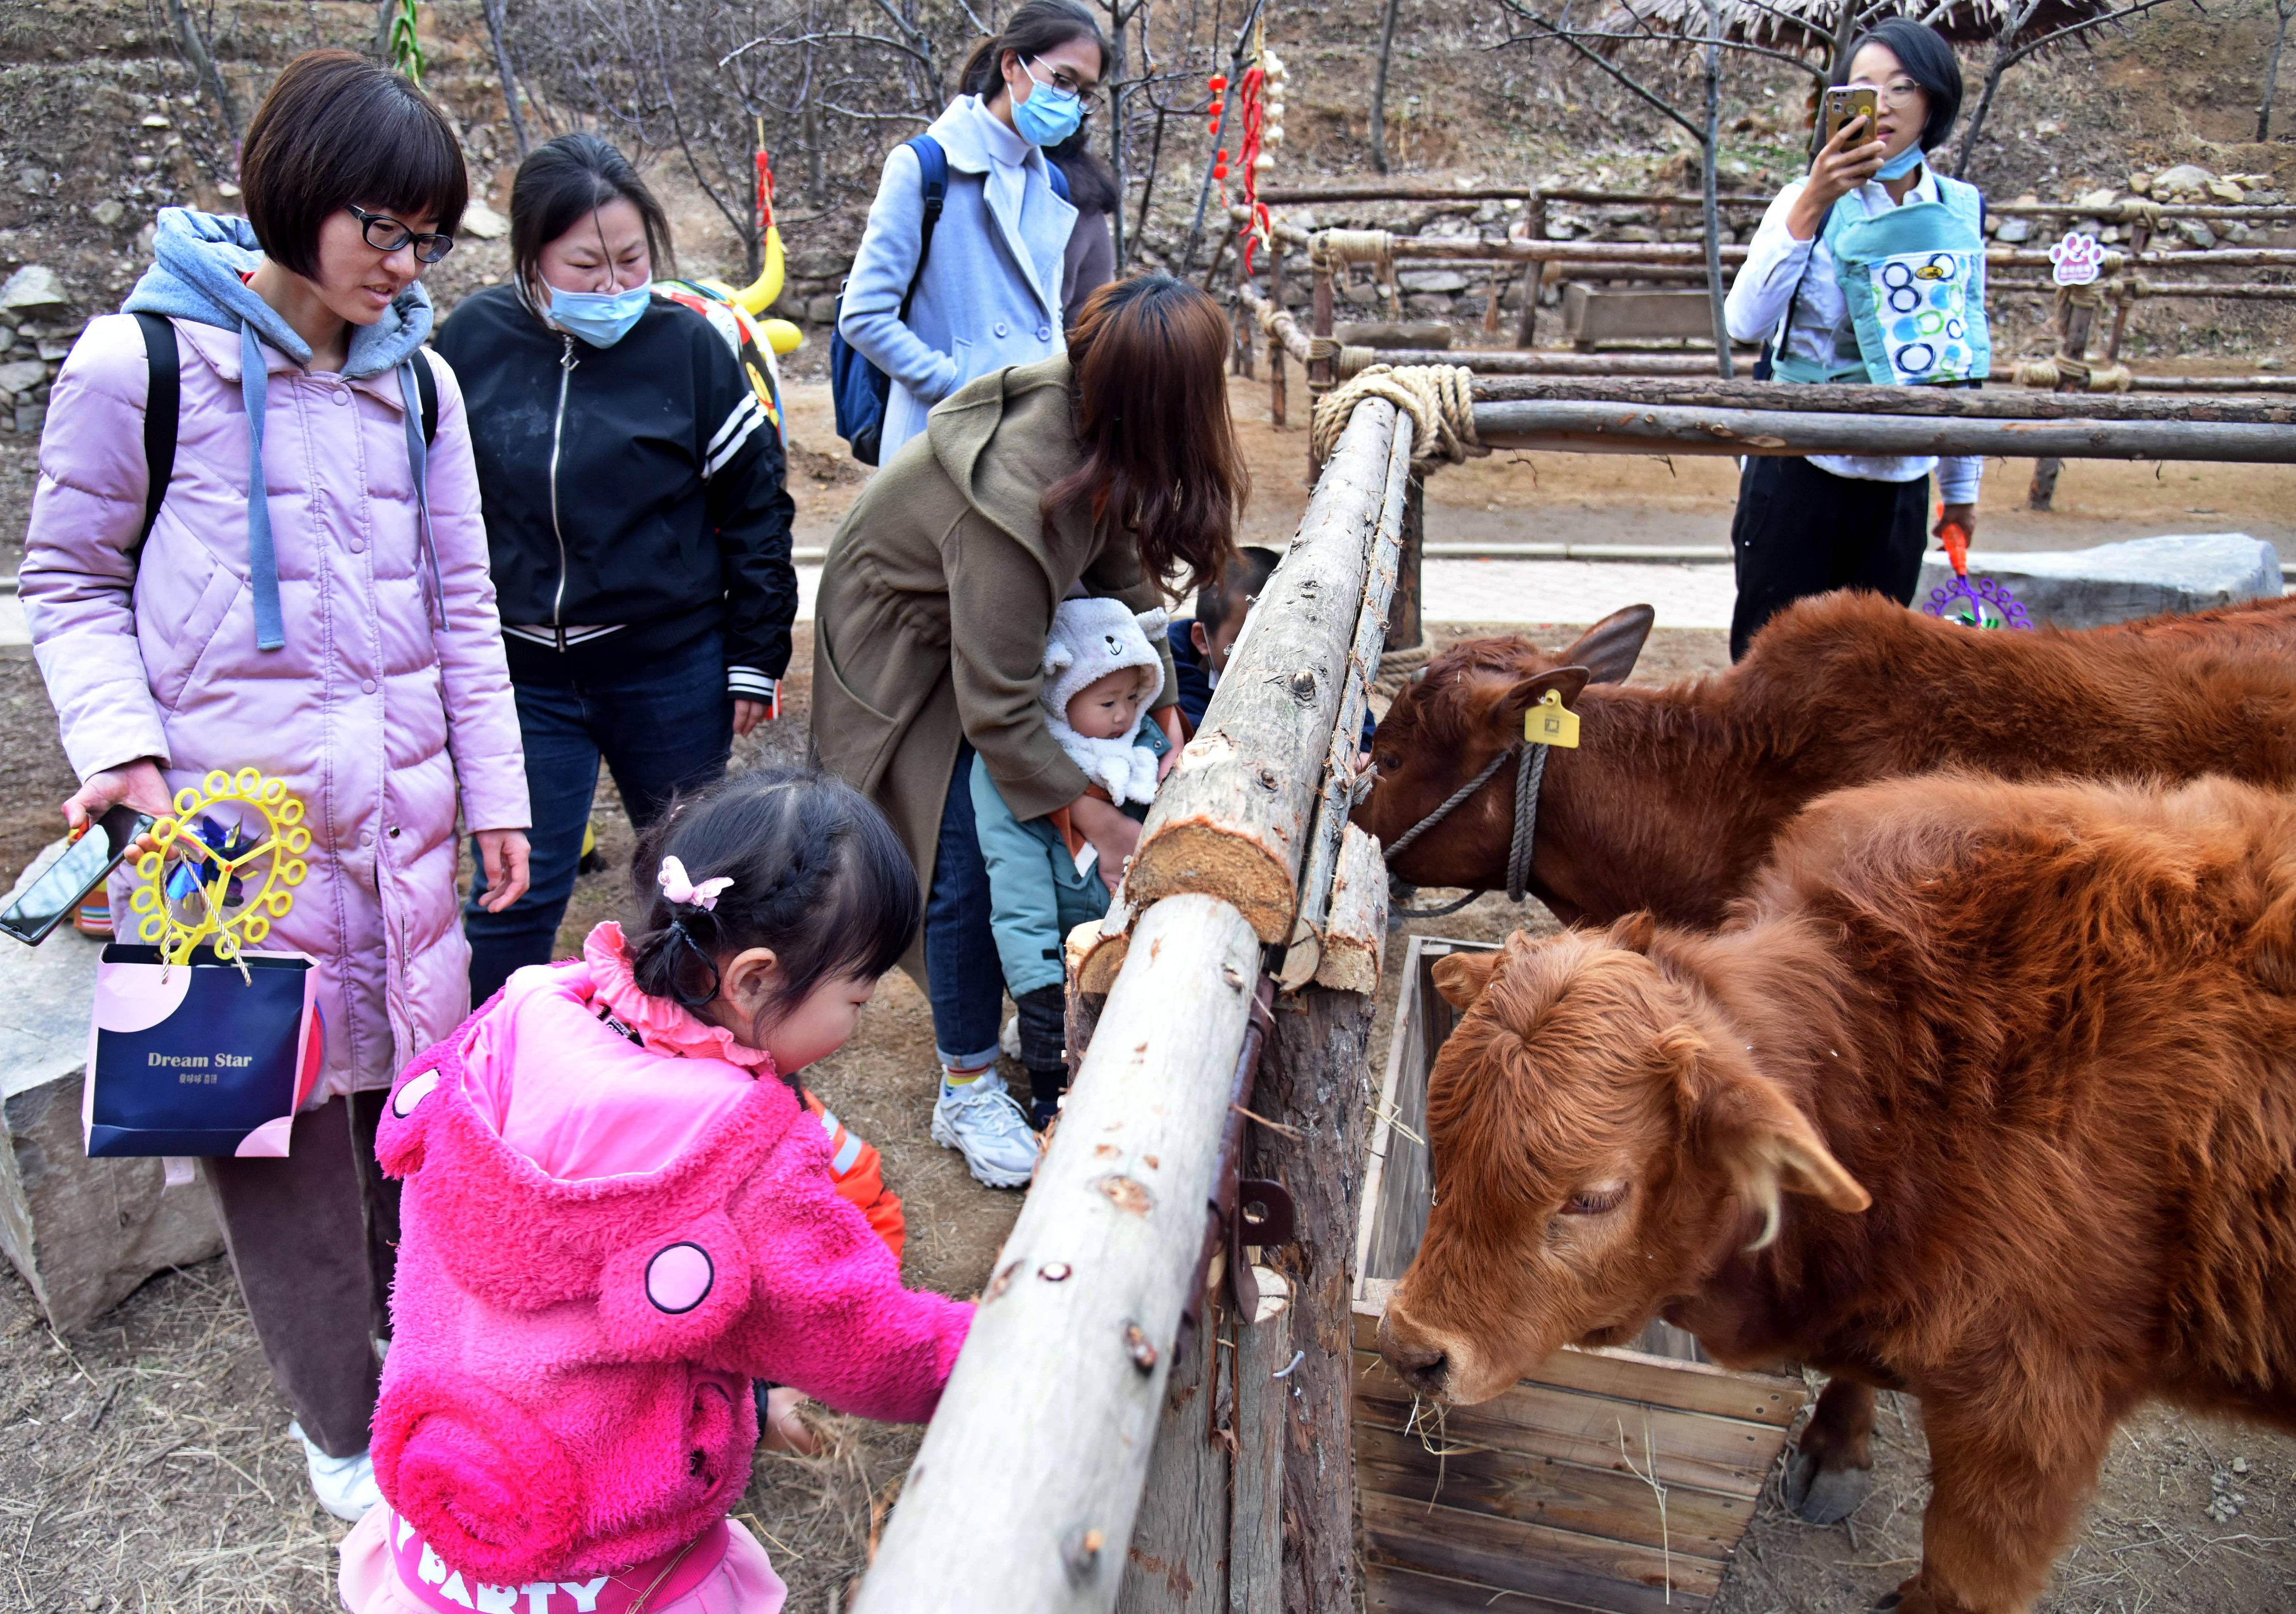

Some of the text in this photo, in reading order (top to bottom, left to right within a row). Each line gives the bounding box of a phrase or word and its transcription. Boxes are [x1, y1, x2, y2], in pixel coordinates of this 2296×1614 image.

[148, 1053, 253, 1067] Dream Star
[418, 1541, 608, 1614] PARTY
